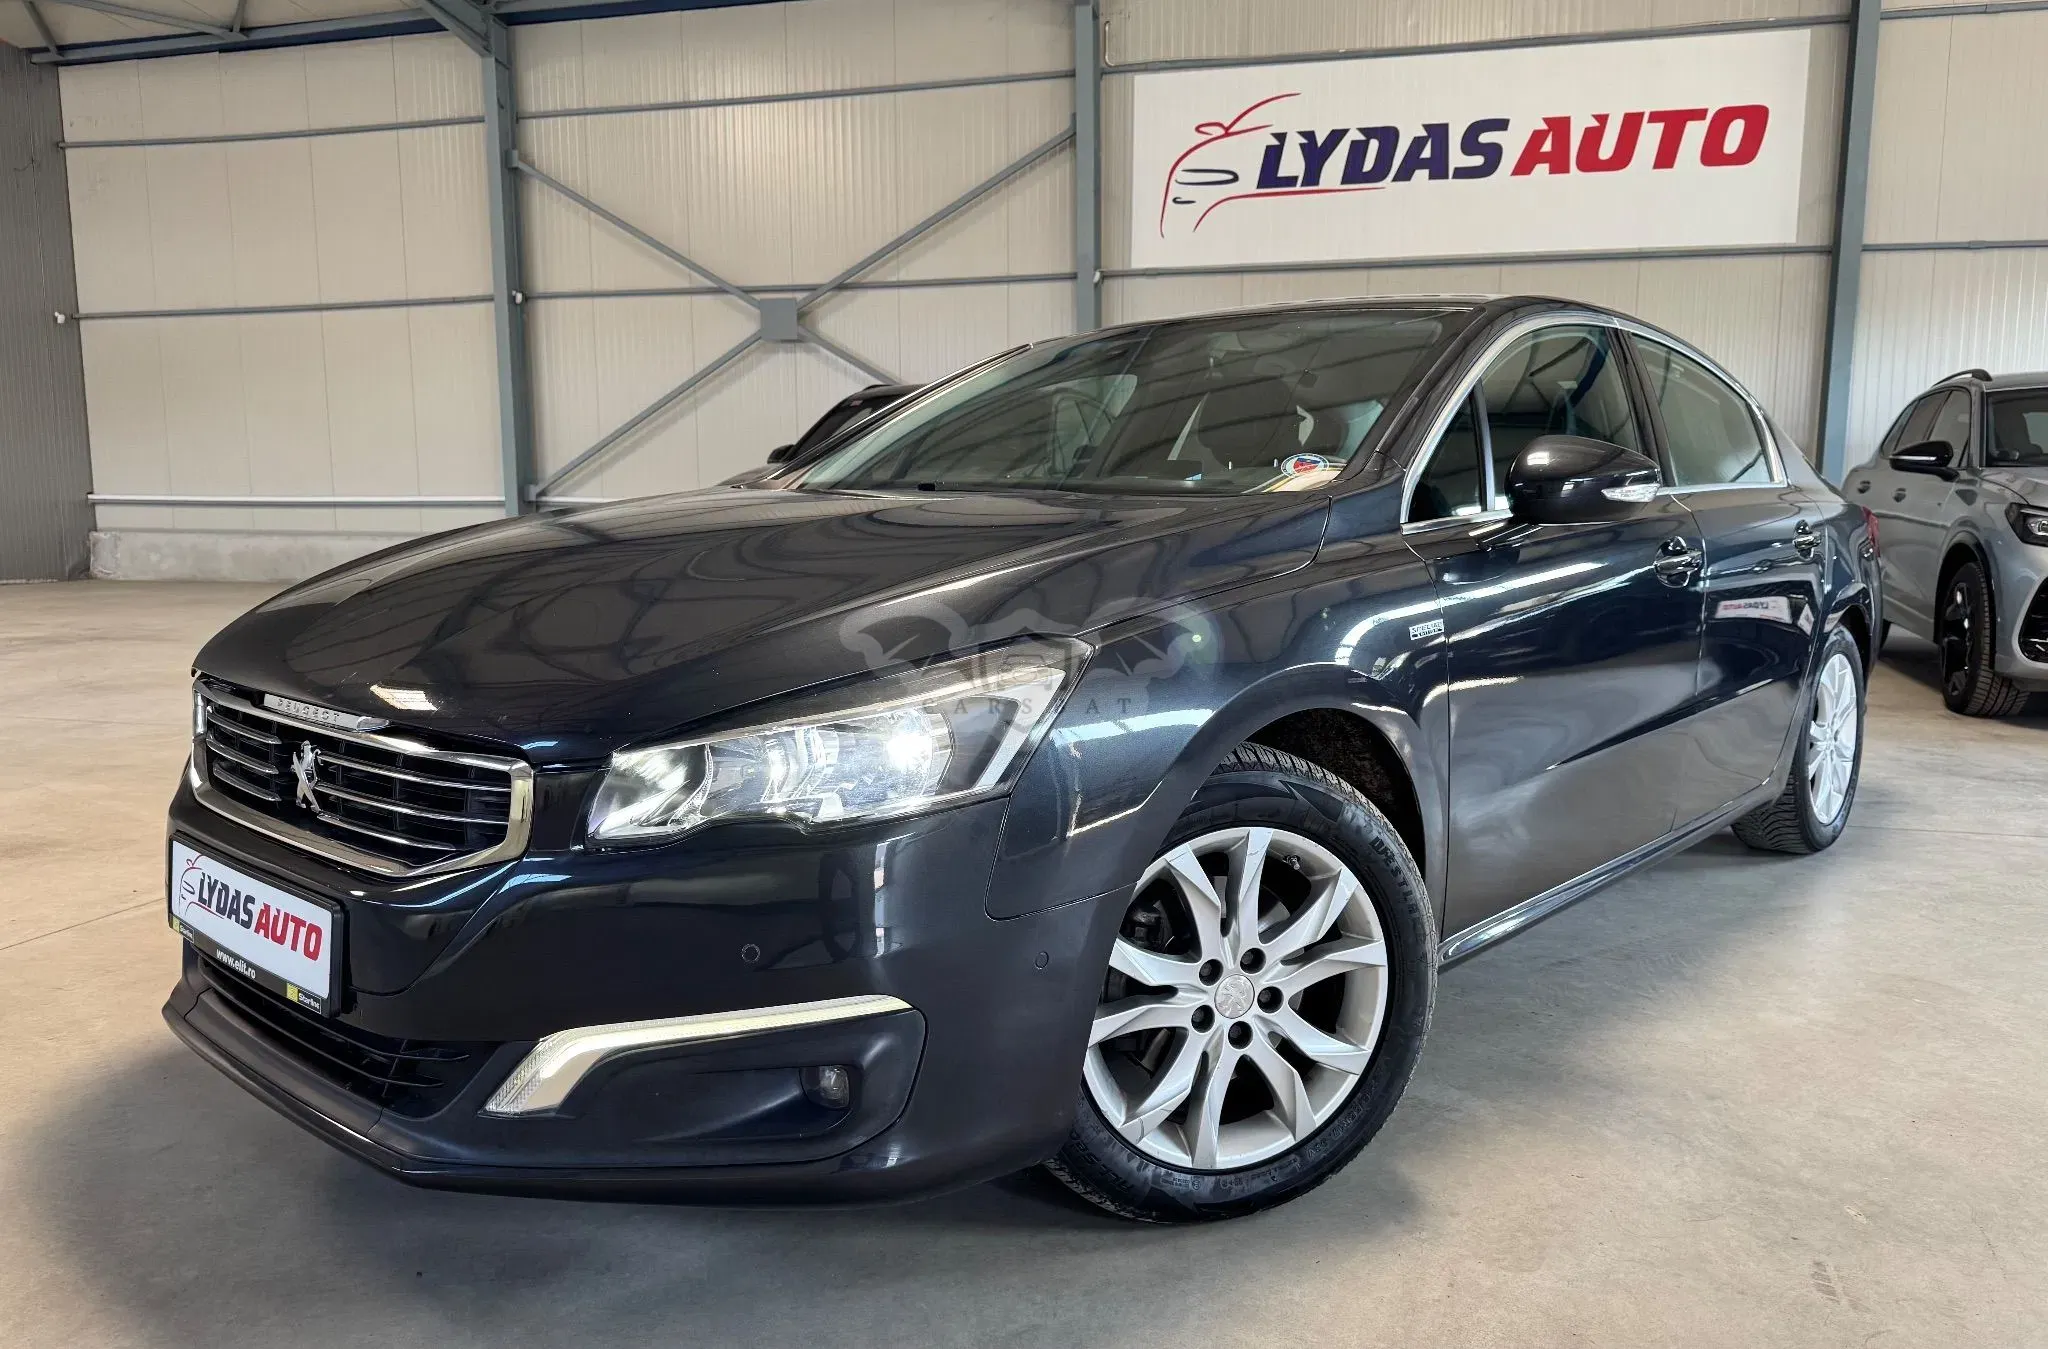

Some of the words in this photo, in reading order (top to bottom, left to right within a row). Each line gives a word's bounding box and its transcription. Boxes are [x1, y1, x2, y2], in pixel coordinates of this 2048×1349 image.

[1256, 118, 1510, 190] LYDAS
[1510, 103, 1770, 176] AUTO
[277, 698, 340, 722] PEUGEOT
[198, 872, 256, 930] LYDAS
[254, 902, 323, 961] AUTO
[216, 949, 256, 979] www.elit.ro
